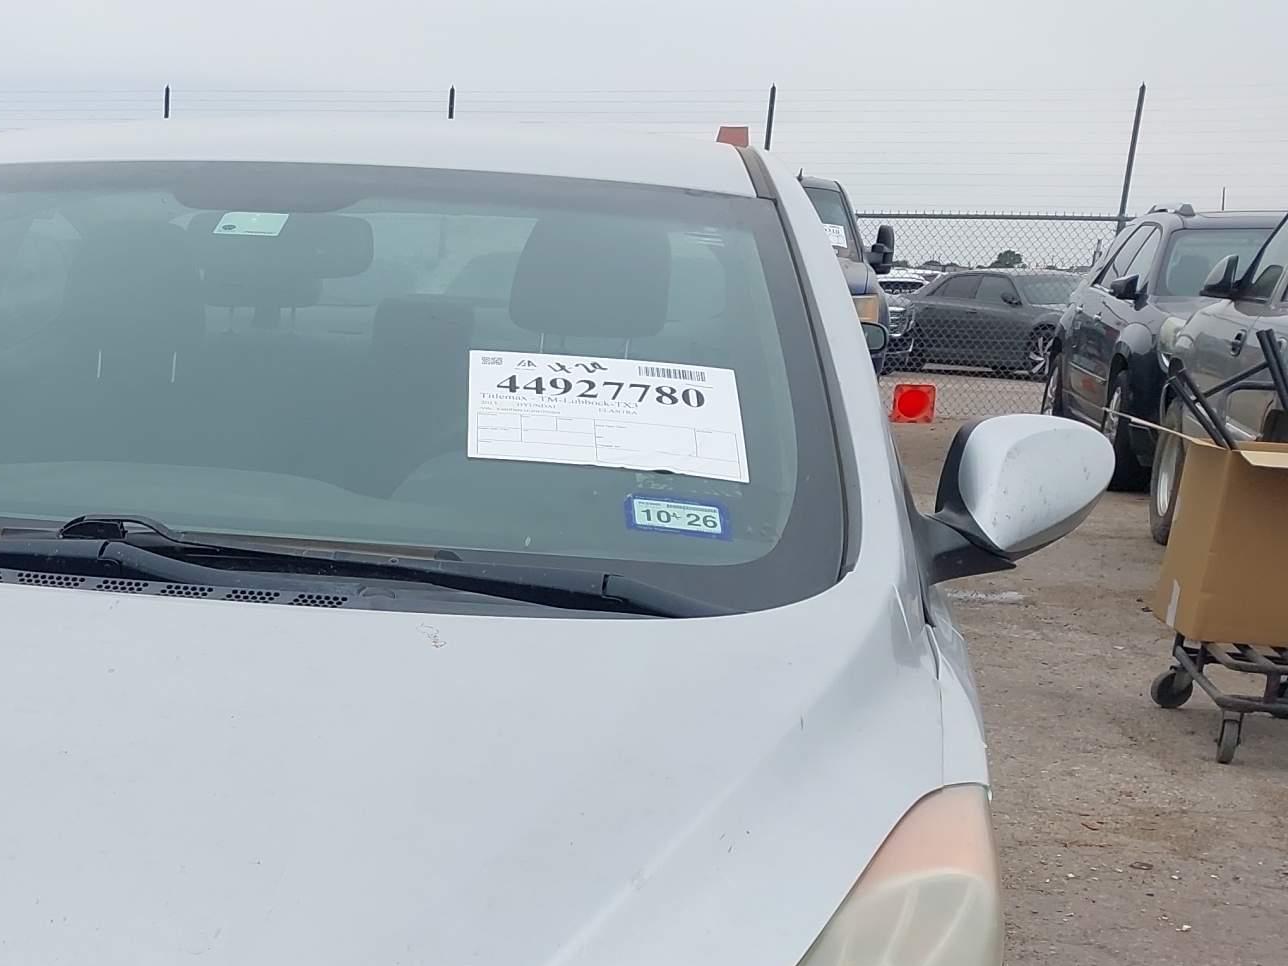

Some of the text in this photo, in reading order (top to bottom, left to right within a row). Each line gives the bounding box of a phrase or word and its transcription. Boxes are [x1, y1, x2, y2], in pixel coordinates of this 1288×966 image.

[496, 374, 706, 408] 44927780
[640, 508, 718, 529] 10 26
